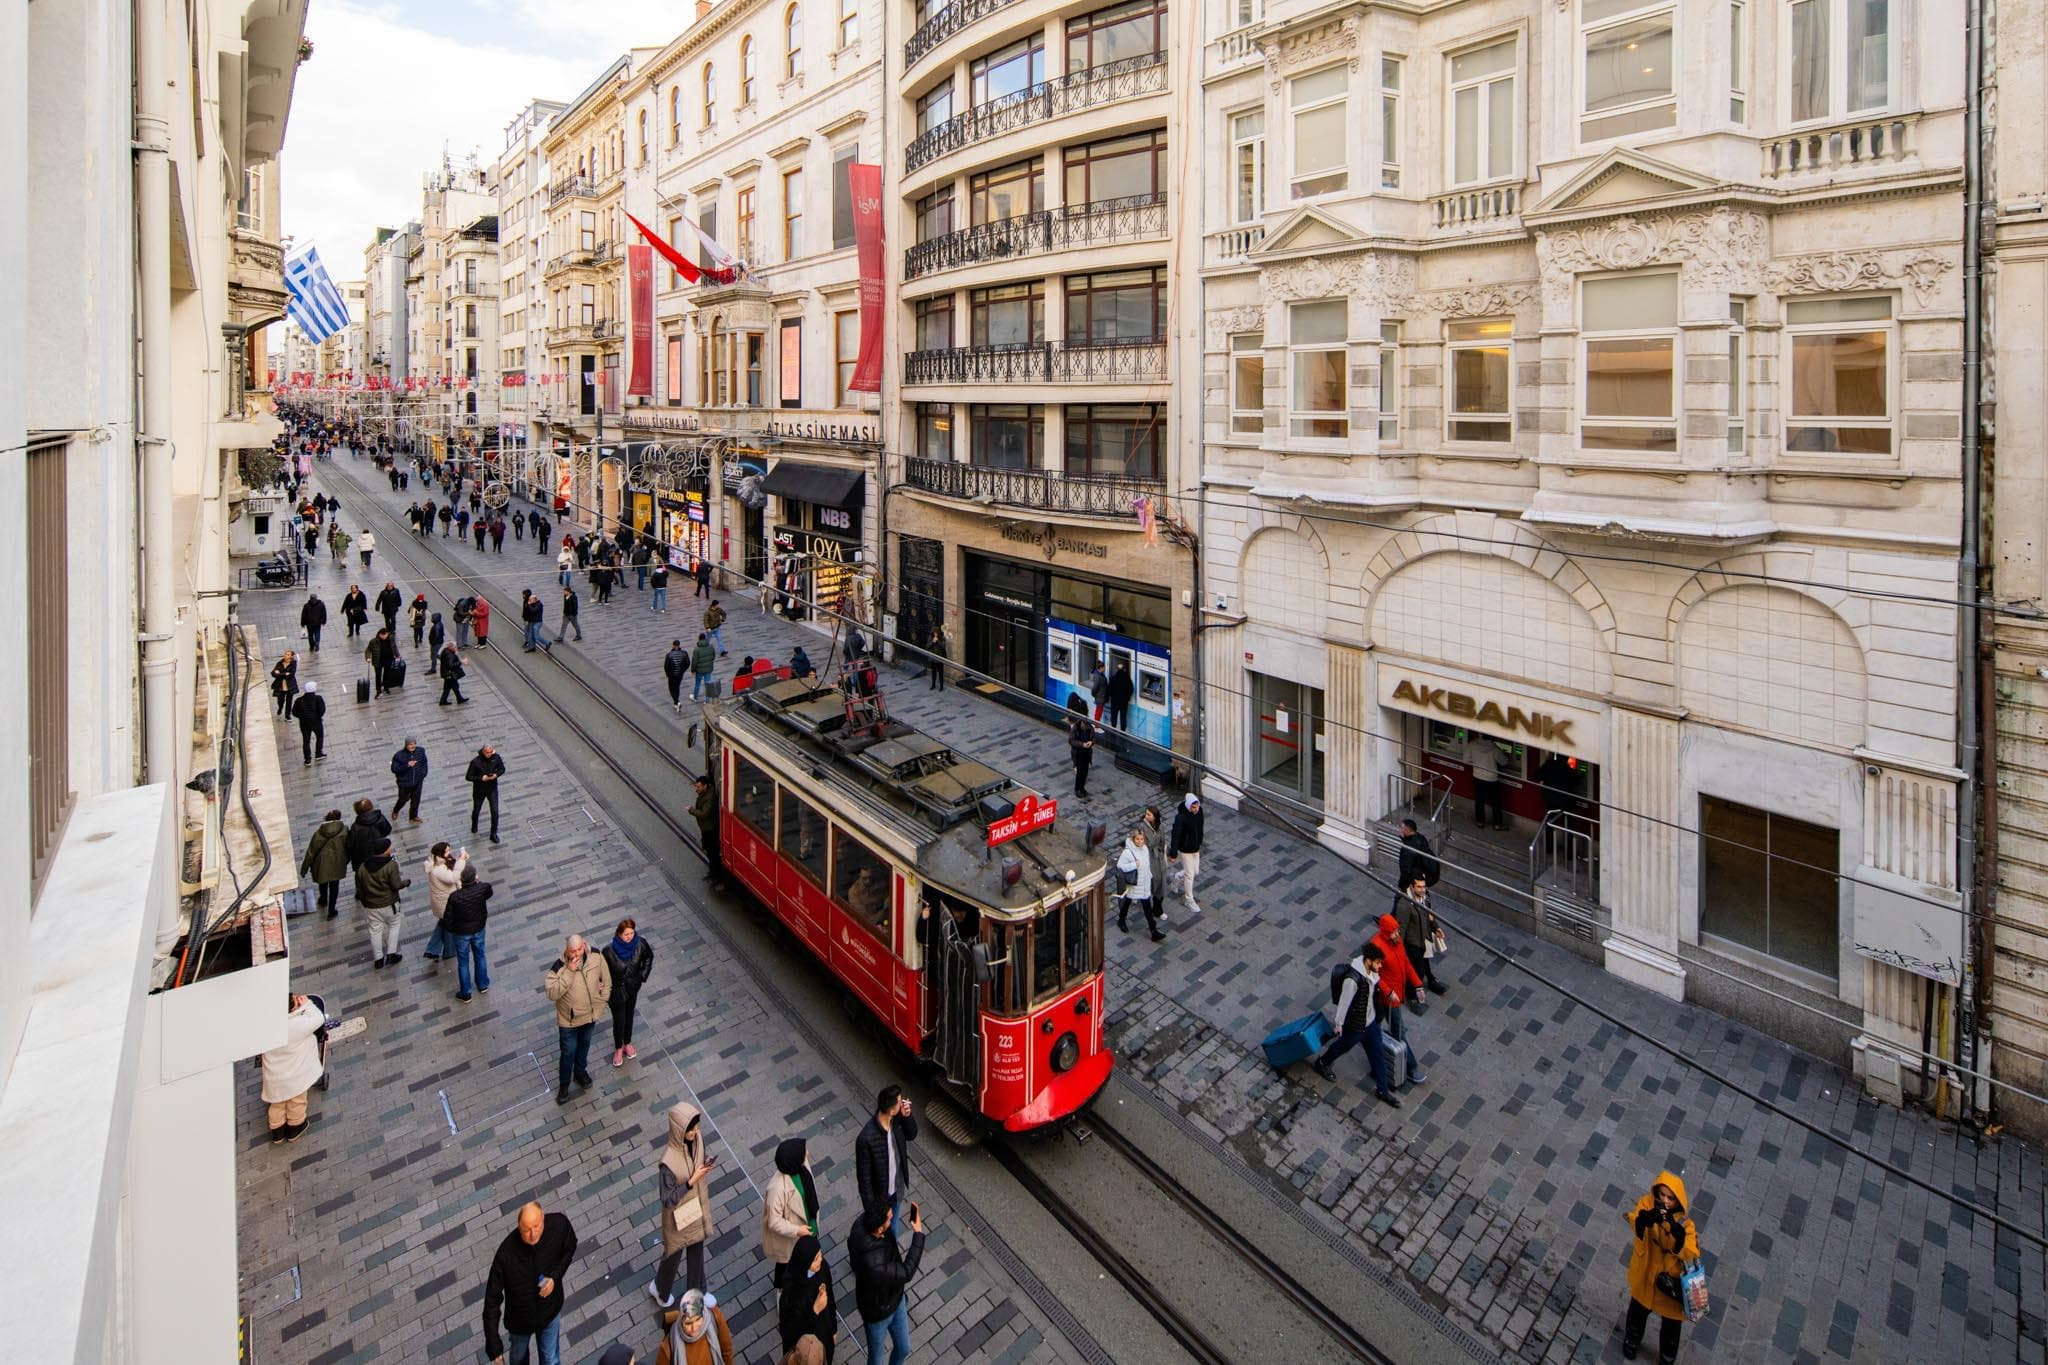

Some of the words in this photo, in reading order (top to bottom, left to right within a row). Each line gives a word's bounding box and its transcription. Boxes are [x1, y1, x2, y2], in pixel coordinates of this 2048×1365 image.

[767, 422, 802, 438] ATLAS
[806, 420, 876, 443] SİNEMASI
[820, 507, 851, 529] NBB
[773, 531, 794, 545] LAST
[1002, 526, 1042, 546] TÜRKİYE
[1056, 537, 1107, 559] BANKASI
[1391, 679, 1577, 747] AKBANK
[1022, 798, 1030, 812] 2
[991, 820, 1019, 841] TAKSİM
[1033, 806, 1055, 825] TÜNEL
[998, 1035, 1014, 1048] 223
